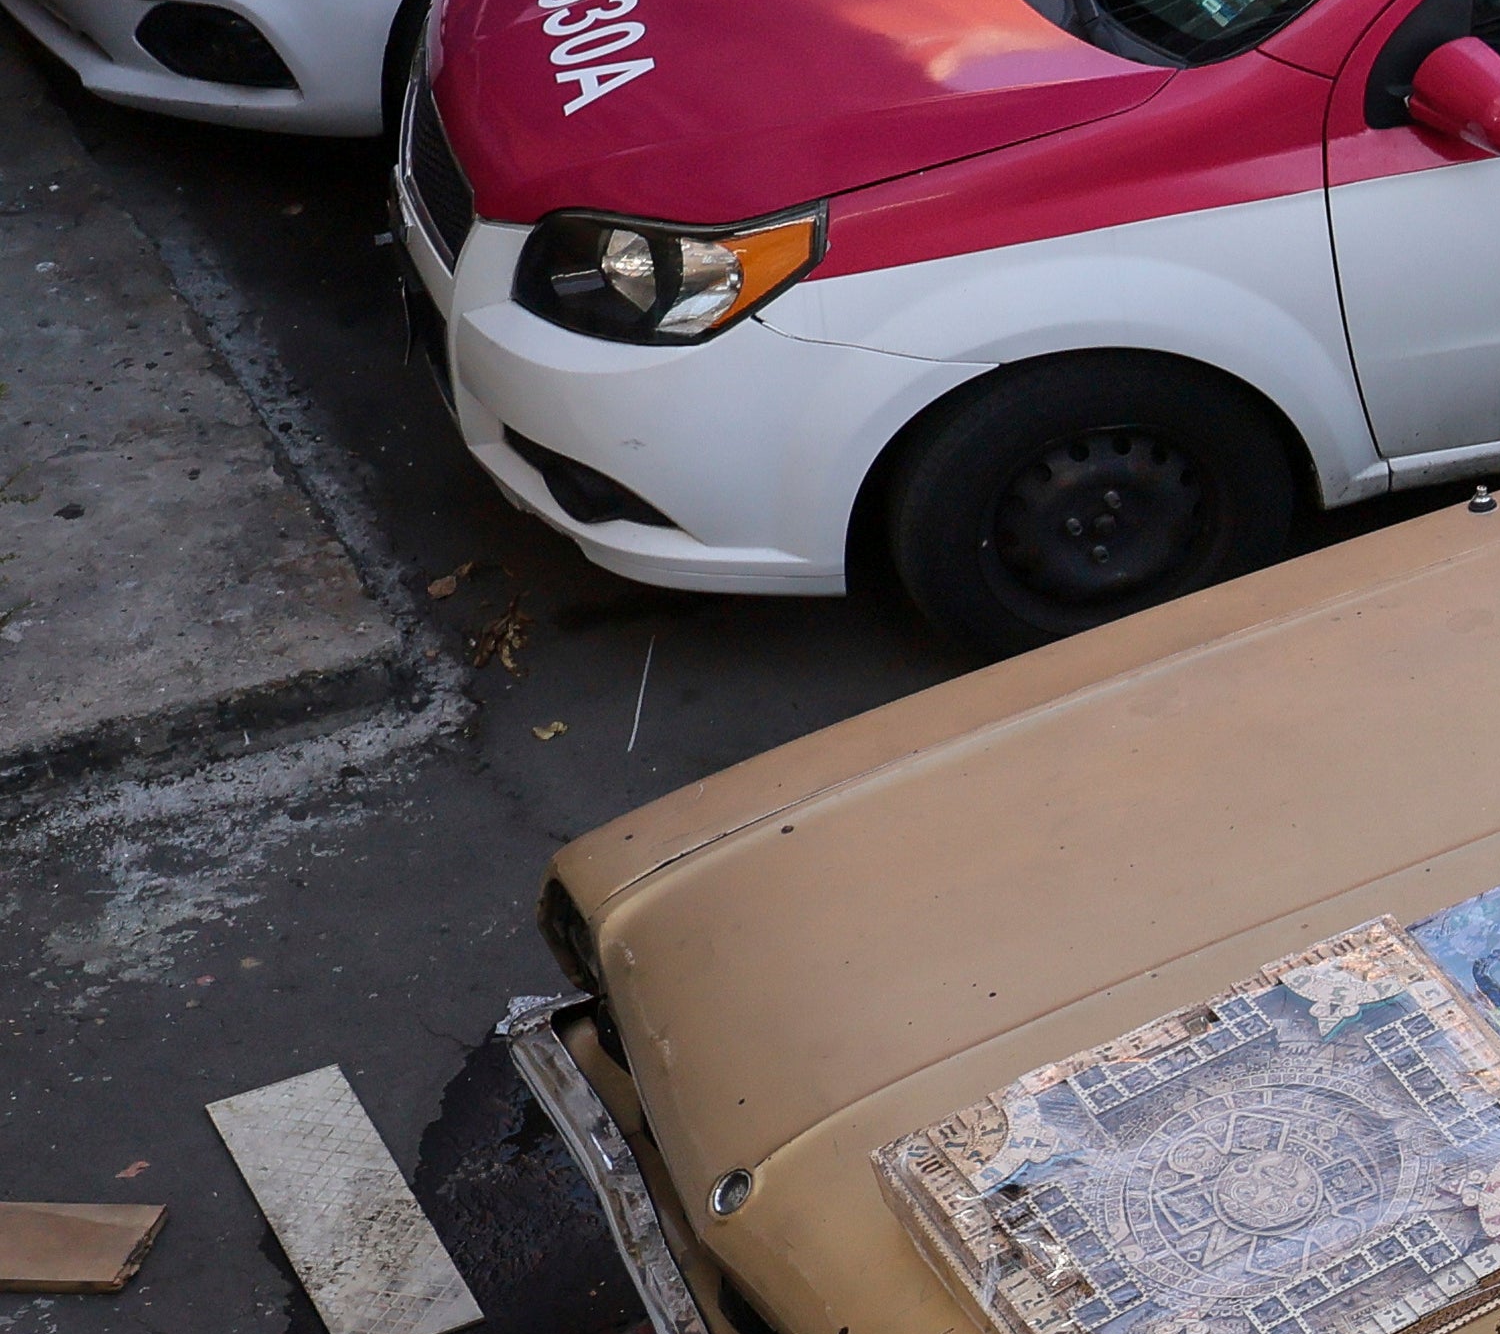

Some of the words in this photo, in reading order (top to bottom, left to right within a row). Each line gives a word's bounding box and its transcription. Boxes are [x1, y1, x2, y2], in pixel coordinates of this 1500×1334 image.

[1390, 1308, 1408, 1324] 2
[1447, 1270, 1467, 1287] 4
[1476, 1250, 1497, 1268] 5
